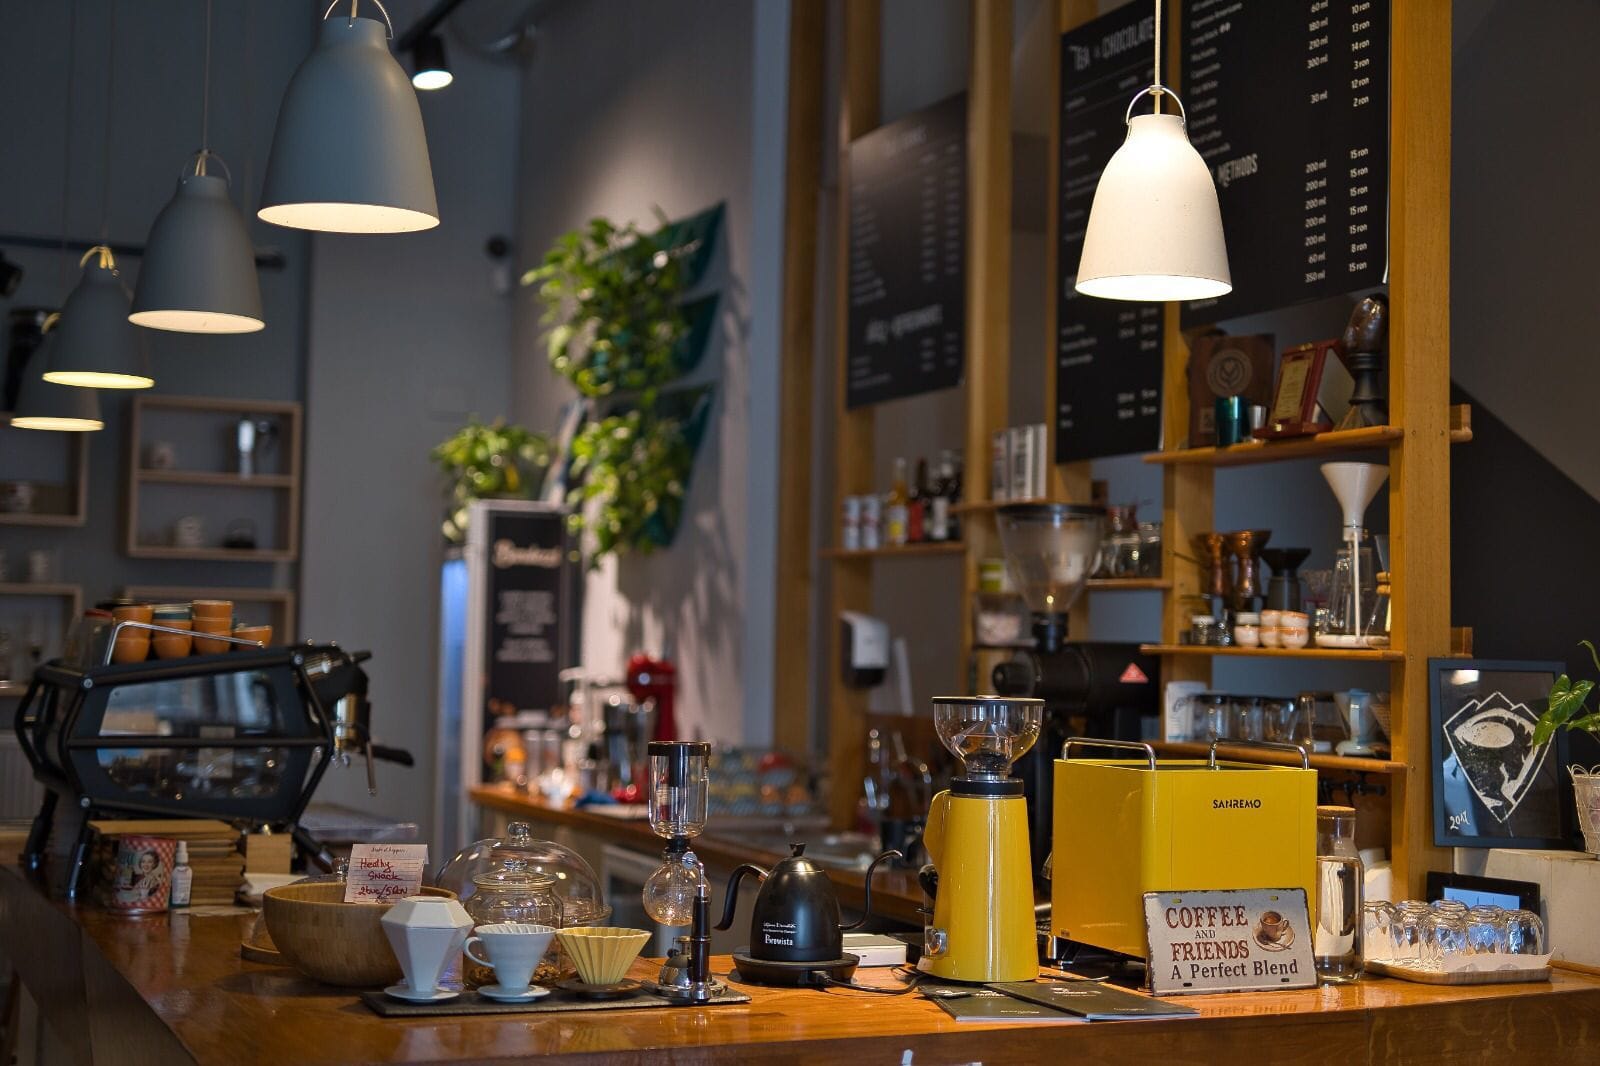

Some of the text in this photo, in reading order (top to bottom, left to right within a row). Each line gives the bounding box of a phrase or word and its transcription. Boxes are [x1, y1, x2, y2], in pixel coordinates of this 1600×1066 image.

[1320, 0, 1329, 8] ml
[1351, 1, 1370, 15] 10 ron
[1320, 16, 1329, 27] ml
[1351, 20, 1370, 33] 13 ron
[1320, 35, 1329, 45] ml
[1351, 39, 1370, 52] 14 ron
[1320, 53, 1329, 63] ml
[1353, 58, 1370, 70] 3 ron
[1351, 77, 1370, 89] 12 ron
[1320, 90, 1328, 100] ml
[1353, 95, 1370, 108] 2 ron
[1350, 147, 1369, 159] 15 ron
[1319, 159, 1327, 168] ml
[1349, 166, 1369, 178] 15 ron
[1319, 177, 1327, 187] ml
[1349, 185, 1369, 197] 15 ron
[1319, 196, 1327, 205] ml
[1349, 204, 1368, 216] 15 ron
[1319, 214, 1327, 224] ml
[1349, 223, 1368, 235] 15 ron
[1319, 232, 1326, 242] ml
[1357, 242, 1368, 251] ron
[1319, 251, 1326, 261] ml
[1348, 261, 1368, 272] 15 ron
[1319, 269, 1326, 279] ml
[1212, 799, 1262, 809] SANREMO
[1165, 905, 1248, 928] COFFEE
[1195, 929, 1216, 939] AND
[1170, 940, 1250, 962] FRIENDS
[1171, 958, 1299, 979] A Perfect Blend
